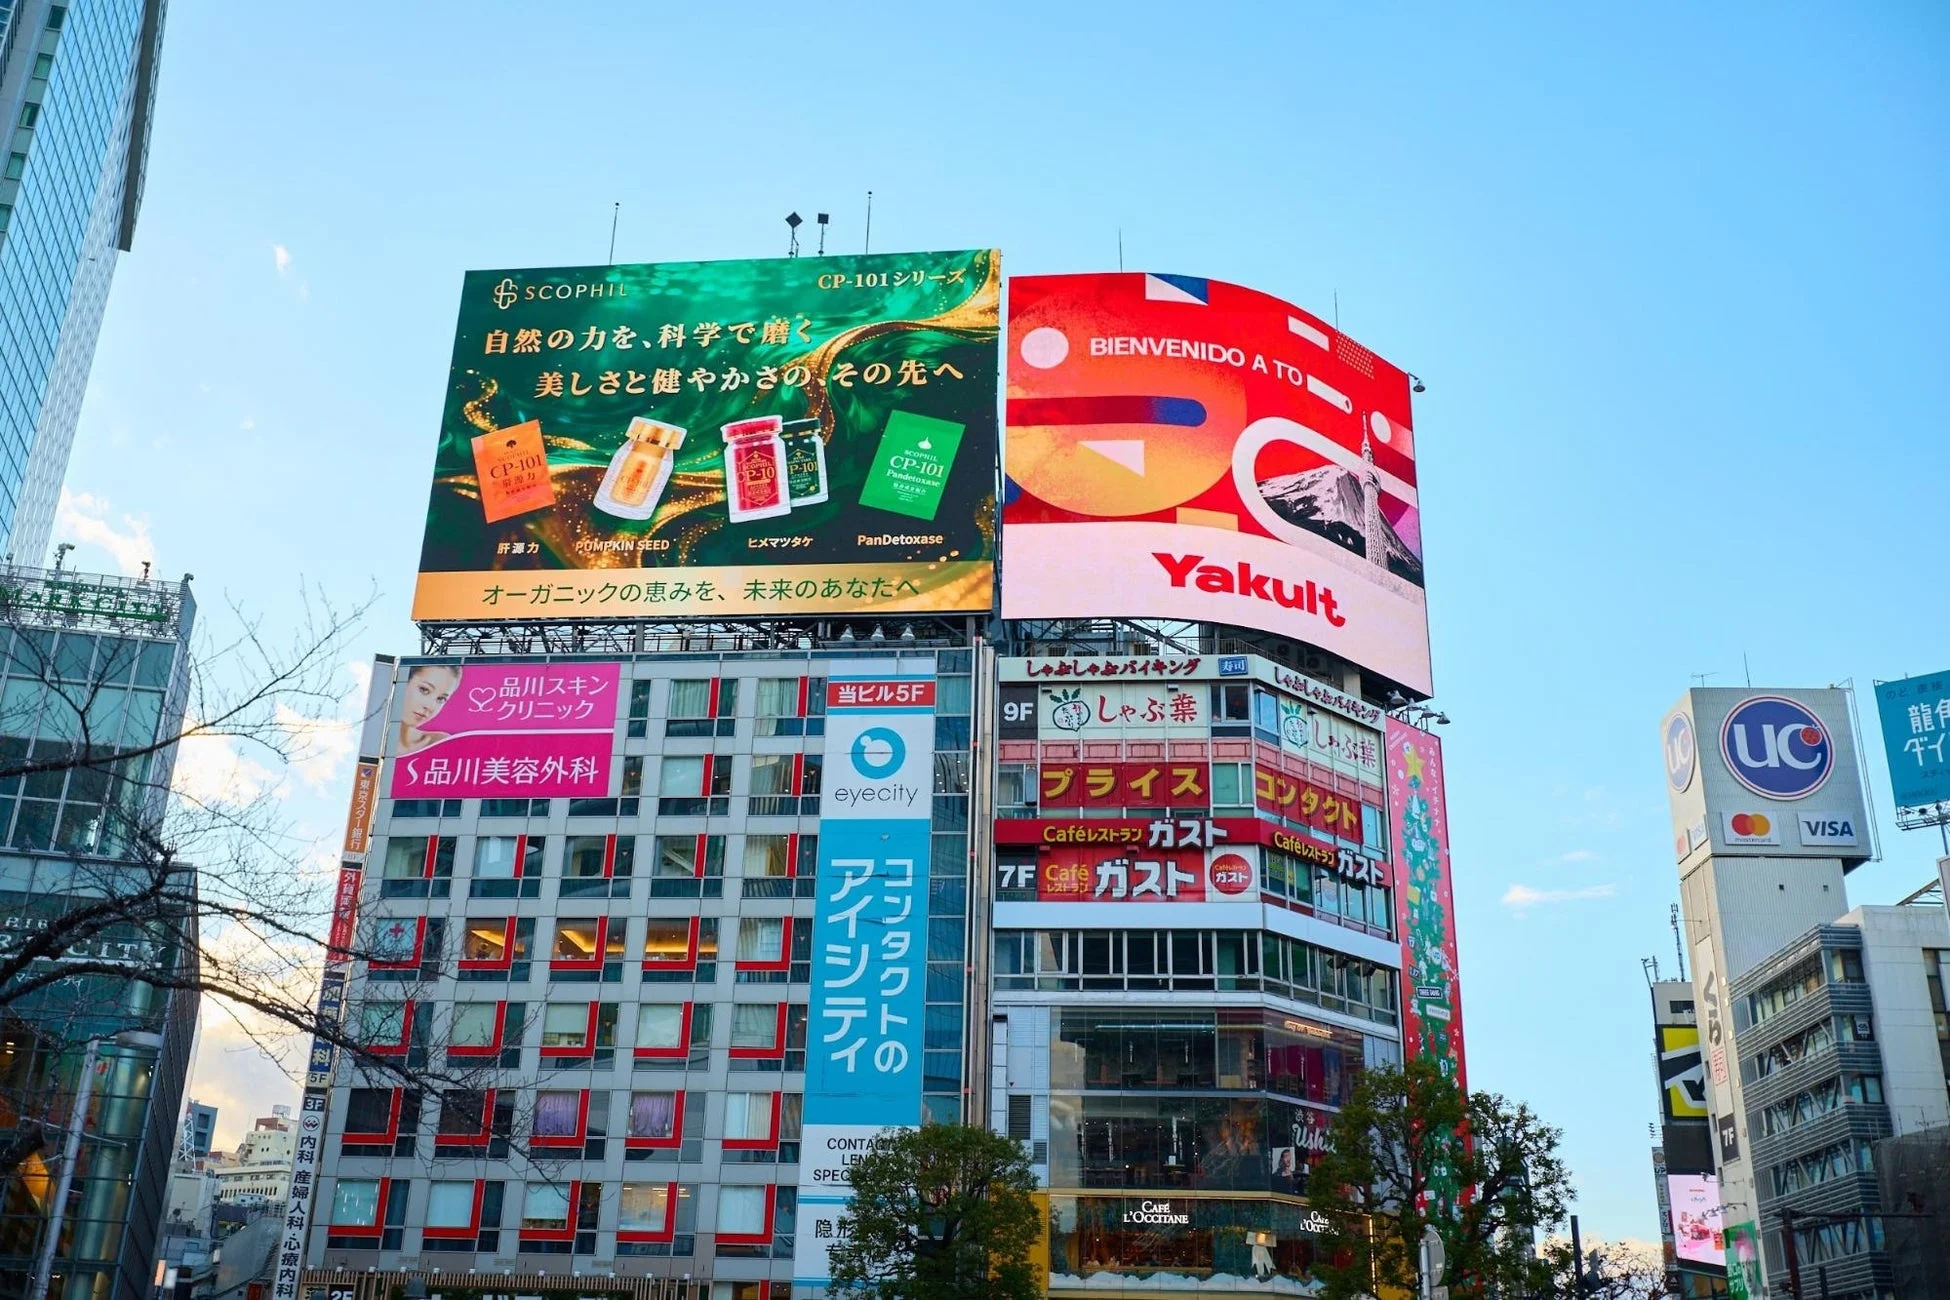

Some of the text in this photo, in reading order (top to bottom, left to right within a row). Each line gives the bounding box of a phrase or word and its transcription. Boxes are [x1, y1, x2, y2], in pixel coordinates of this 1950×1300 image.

[817, 267, 967, 290] CP-101シリーズ
[524, 282, 628, 301] SCOPHIL
[484, 318, 812, 356] 自然の力を、科学で磨く
[1090, 336, 1303, 387] BIENVENIDO A TO
[534, 359, 965, 399] 美しさと健やかさの、その先へ
[490, 454, 542, 479] CP-101
[890, 455, 944, 478] CP-101
[497, 541, 540, 555] 肝源力
[575, 539, 670, 553] PUMPKIN SEED
[748, 536, 814, 550] ヒメマツタケ
[857, 533, 944, 547] PanDetoxase
[1152, 553, 1346, 628] Yakult
[1026, 657, 1201, 678] しゃぶしゃぶバイキング
[498, 675, 609, 698] 品川スキン
[837, 683, 925, 704] 当ビル5F
[496, 699, 594, 721] クリニック
[1003, 702, 1033, 722] 9F
[1098, 693, 1198, 724] しゃぶ葉
[1314, 718, 1377, 769] しゃぶ葉
[1733, 723, 1822, 770] UC
[1903, 731, 1950, 767] ダイ
[424, 755, 600, 786] 品川美容外科
[1042, 768, 1204, 799] プライス
[834, 784, 918, 808] eyecity
[1256, 770, 1358, 830] コンタクト
[351, 779, 371, 851] 東京スター銀行
[1148, 819, 1228, 848] ガスト
[1801, 820, 1854, 837] VISA
[998, 865, 1036, 888] 7F
[1046, 864, 1089, 882] Café
[1095, 858, 1195, 898] ガスト
[1215, 871, 1249, 884] ガスト
[1338, 849, 1384, 885] ガスト
[1047, 882, 1089, 893] レストラン
[822, 858, 875, 1073] アイシティ
[874, 858, 914, 1074] コンタクトの
[310, 1073, 328, 1083] 5F
[304, 1099, 323, 1111] 3F
[827, 1138, 895, 1151] CONTAC
[1722, 1127, 1735, 1148] 7F
[297, 1136, 317, 1164] 内科
[842, 1154, 876, 1166] LEN
[1123, 1210, 1189, 1224] L'OCCITANE
